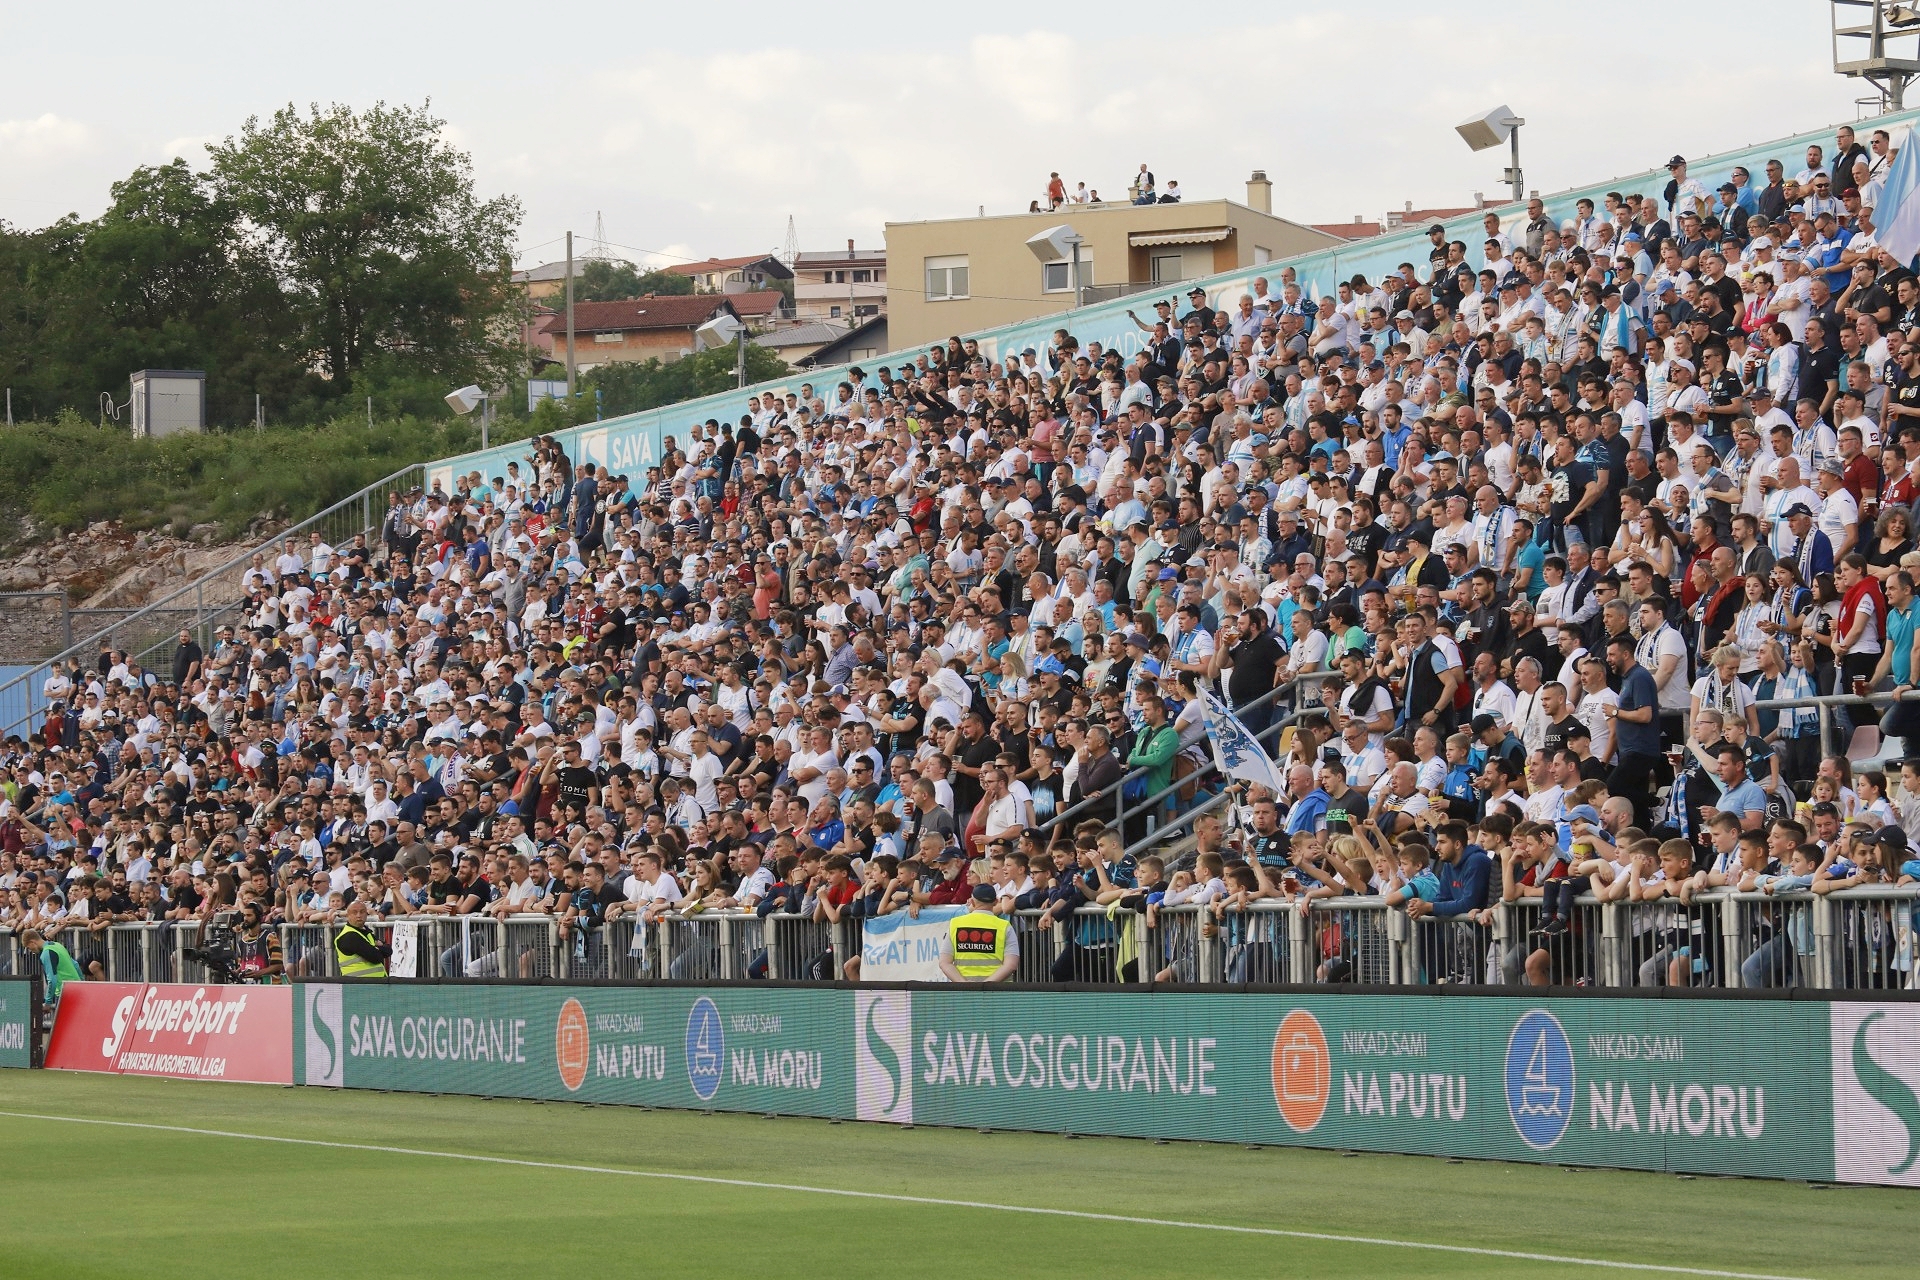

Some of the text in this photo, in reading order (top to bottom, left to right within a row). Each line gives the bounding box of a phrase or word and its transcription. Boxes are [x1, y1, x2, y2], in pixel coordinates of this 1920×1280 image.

[612, 431, 653, 470] SAVA
[957, 942, 994, 951] SECURITAS
[135, 986, 248, 1045] SuperSport
[595, 1013, 645, 1034] NIKAD SAMI
[730, 1013, 783, 1035] NIKAD SAMI
[350, 1014, 526, 1063] SAVA OSIGURANJE
[1342, 1030, 1428, 1058] NIKAD SAMI
[1588, 1034, 1684, 1063] NIKAD SAMI
[117, 1051, 227, 1077] HRVATSKA NOGOMETNA LIGA
[596, 1043, 666, 1081] NA PUTU
[731, 1049, 822, 1090] NA MORU
[922, 1030, 1218, 1096] SAVA OSIGURANJE
[1342, 1071, 1468, 1122] NA PUTU
[1588, 1079, 1766, 1140] NA MORU
